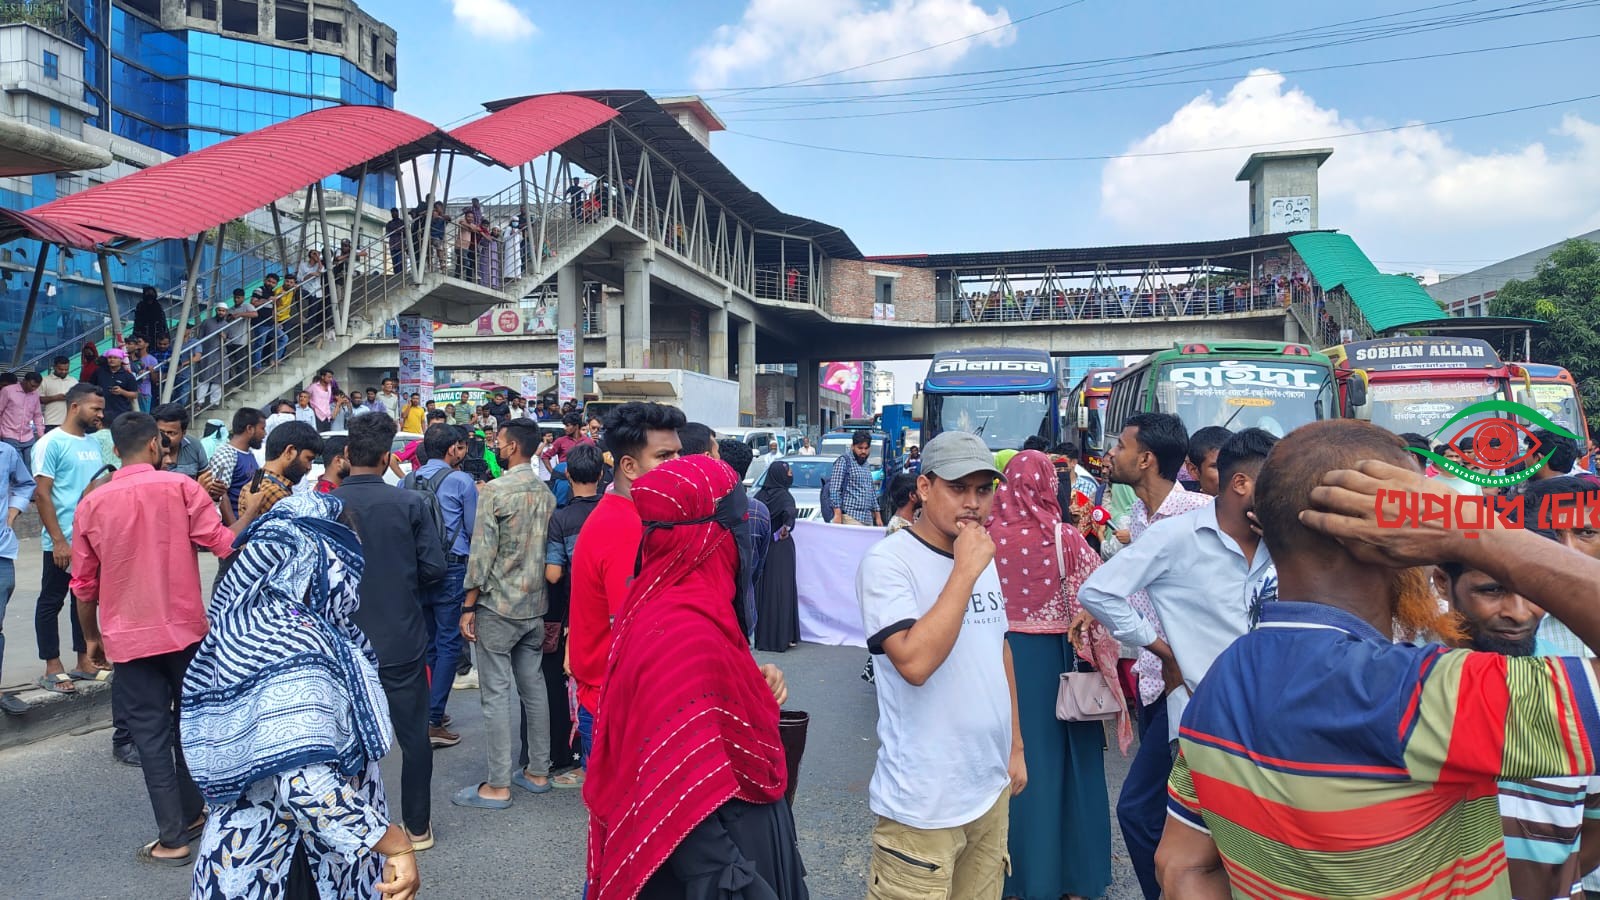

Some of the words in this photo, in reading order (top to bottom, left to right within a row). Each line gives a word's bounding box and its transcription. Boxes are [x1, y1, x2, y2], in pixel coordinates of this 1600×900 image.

[1356, 345, 1424, 361] SOBHAN
[1429, 345, 1484, 357] ALLAH
[934, 359, 1049, 374] নীলাচল
[1169, 360, 1321, 391] রাইদা
